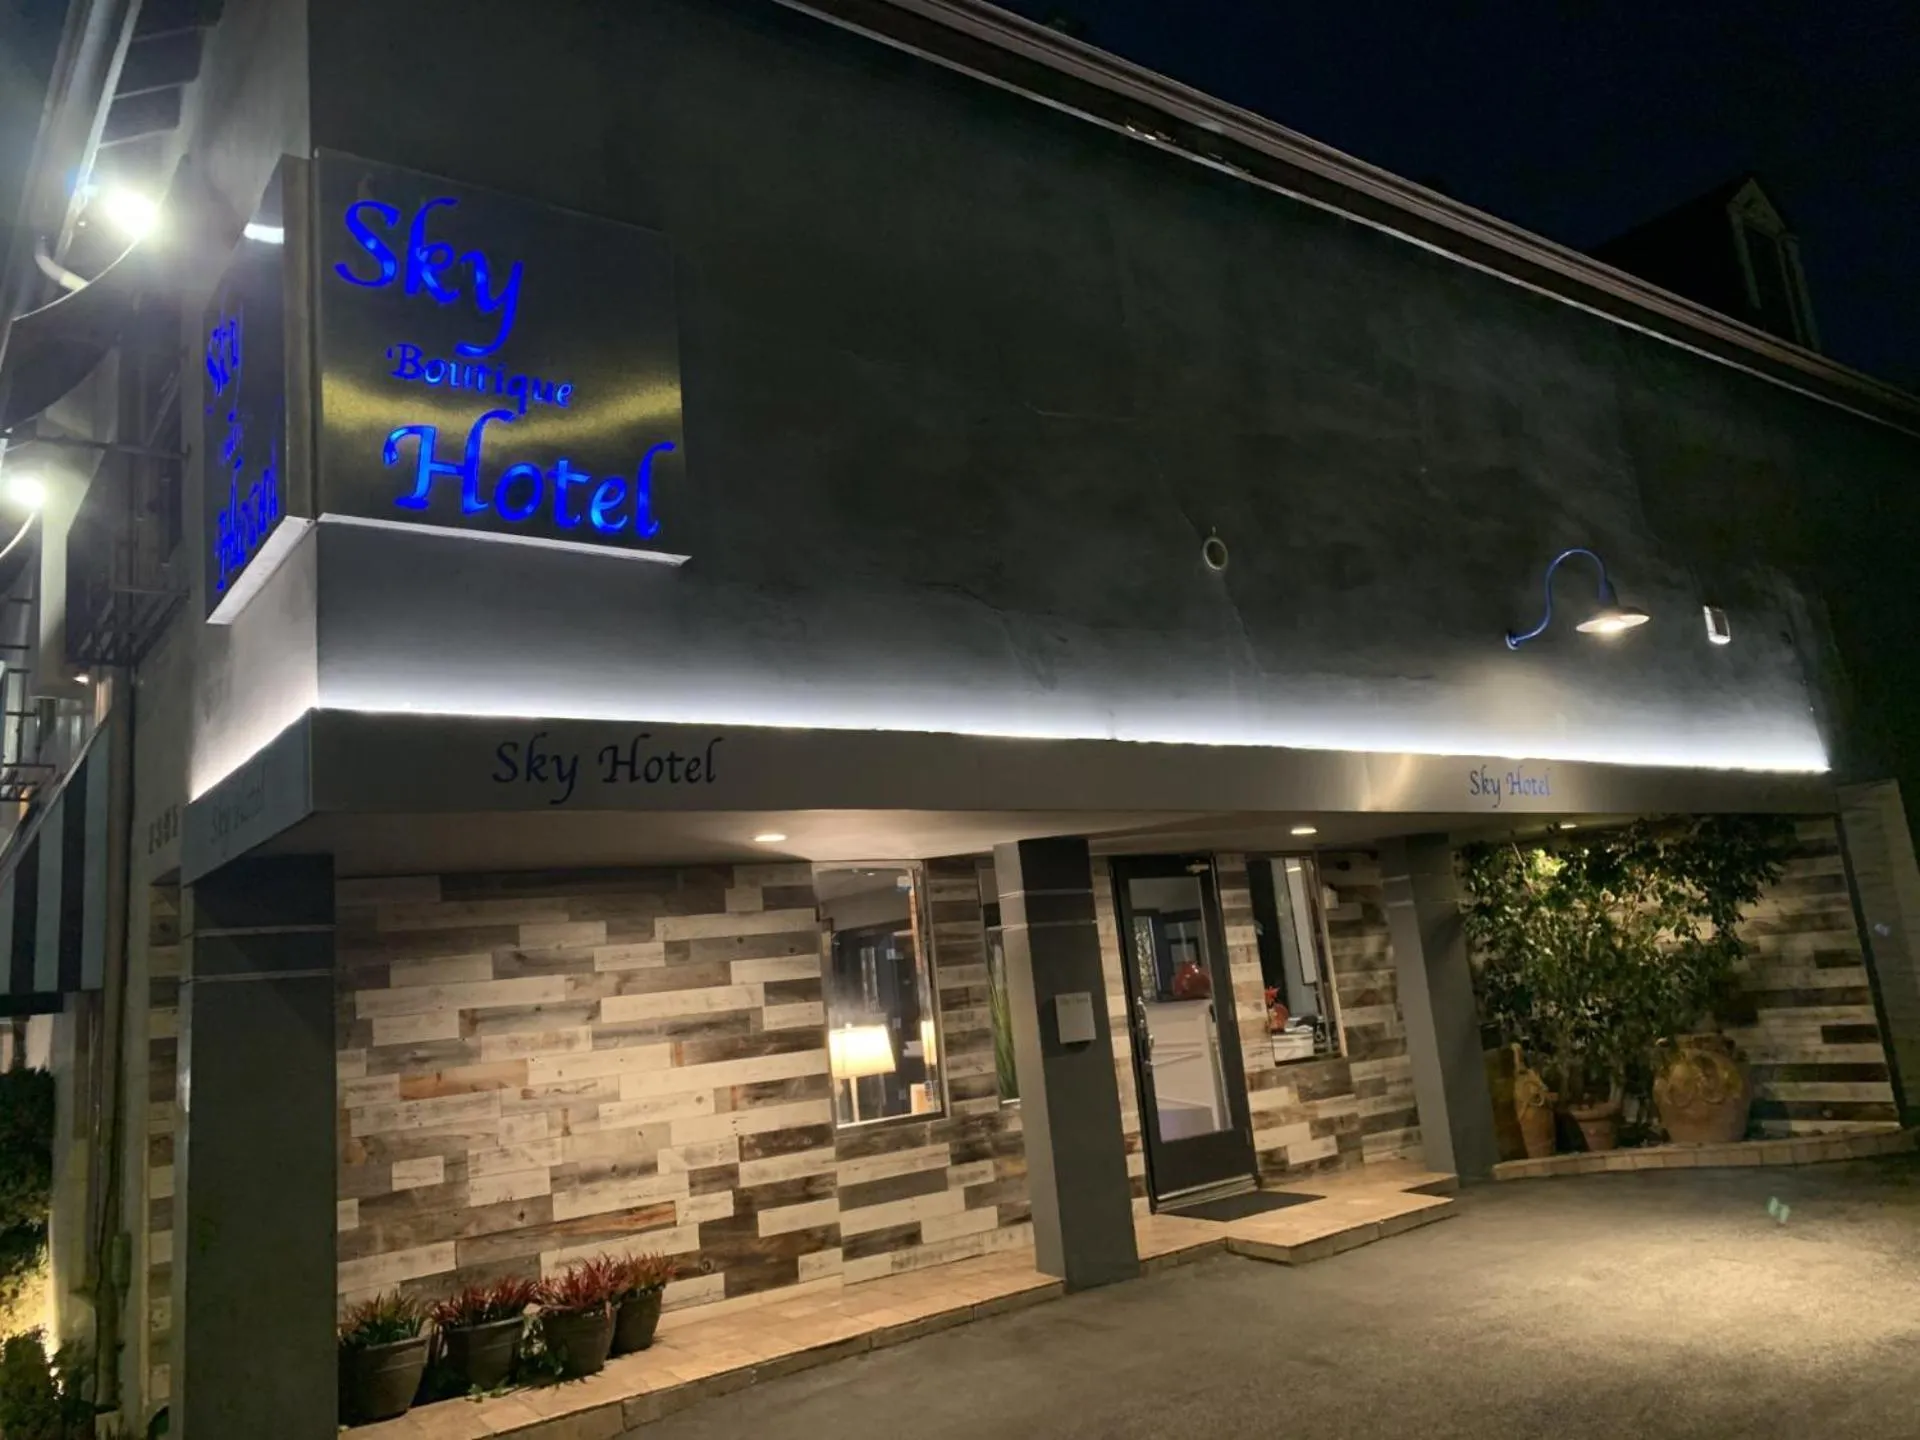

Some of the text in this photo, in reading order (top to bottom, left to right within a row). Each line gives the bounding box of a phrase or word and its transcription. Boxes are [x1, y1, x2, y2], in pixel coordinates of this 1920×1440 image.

[333, 196, 525, 358] Sky
[385, 342, 575, 416] Boutique
[381, 408, 676, 541] Hotel
[491, 731, 725, 806] Sky Hotel
[1469, 763, 1552, 809] Sky Hotel
